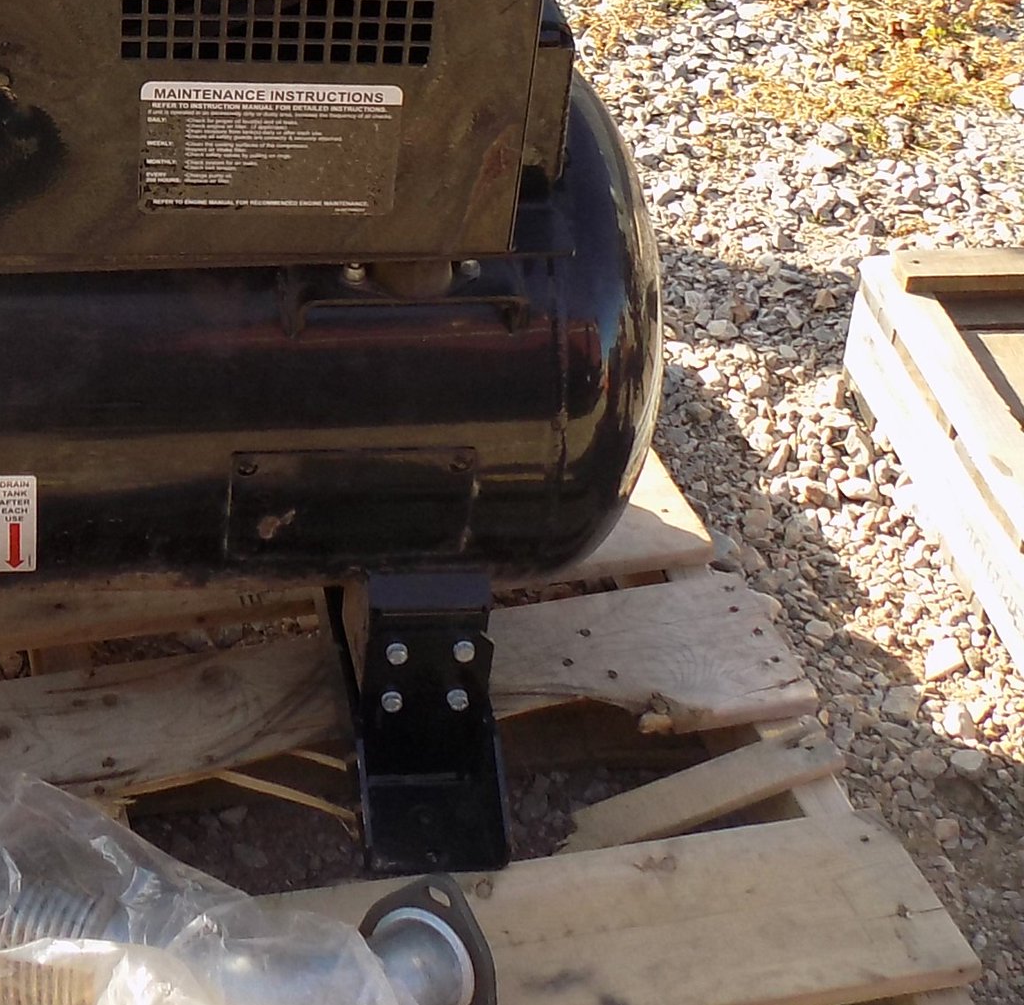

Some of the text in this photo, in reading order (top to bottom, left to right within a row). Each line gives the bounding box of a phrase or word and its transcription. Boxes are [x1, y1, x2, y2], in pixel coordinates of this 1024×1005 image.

[153, 87, 384, 104] MAINTENANCE INSTRUCTIONS
[152, 101, 177, 109] REFER
[190, 102, 241, 111] INSTRUCTION
[242, 103, 274, 111] MANUAL
[293, 104, 330, 112] DETAILED
[0, 481, 30, 489] DRAIN
[1, 507, 28, 515] EACH
